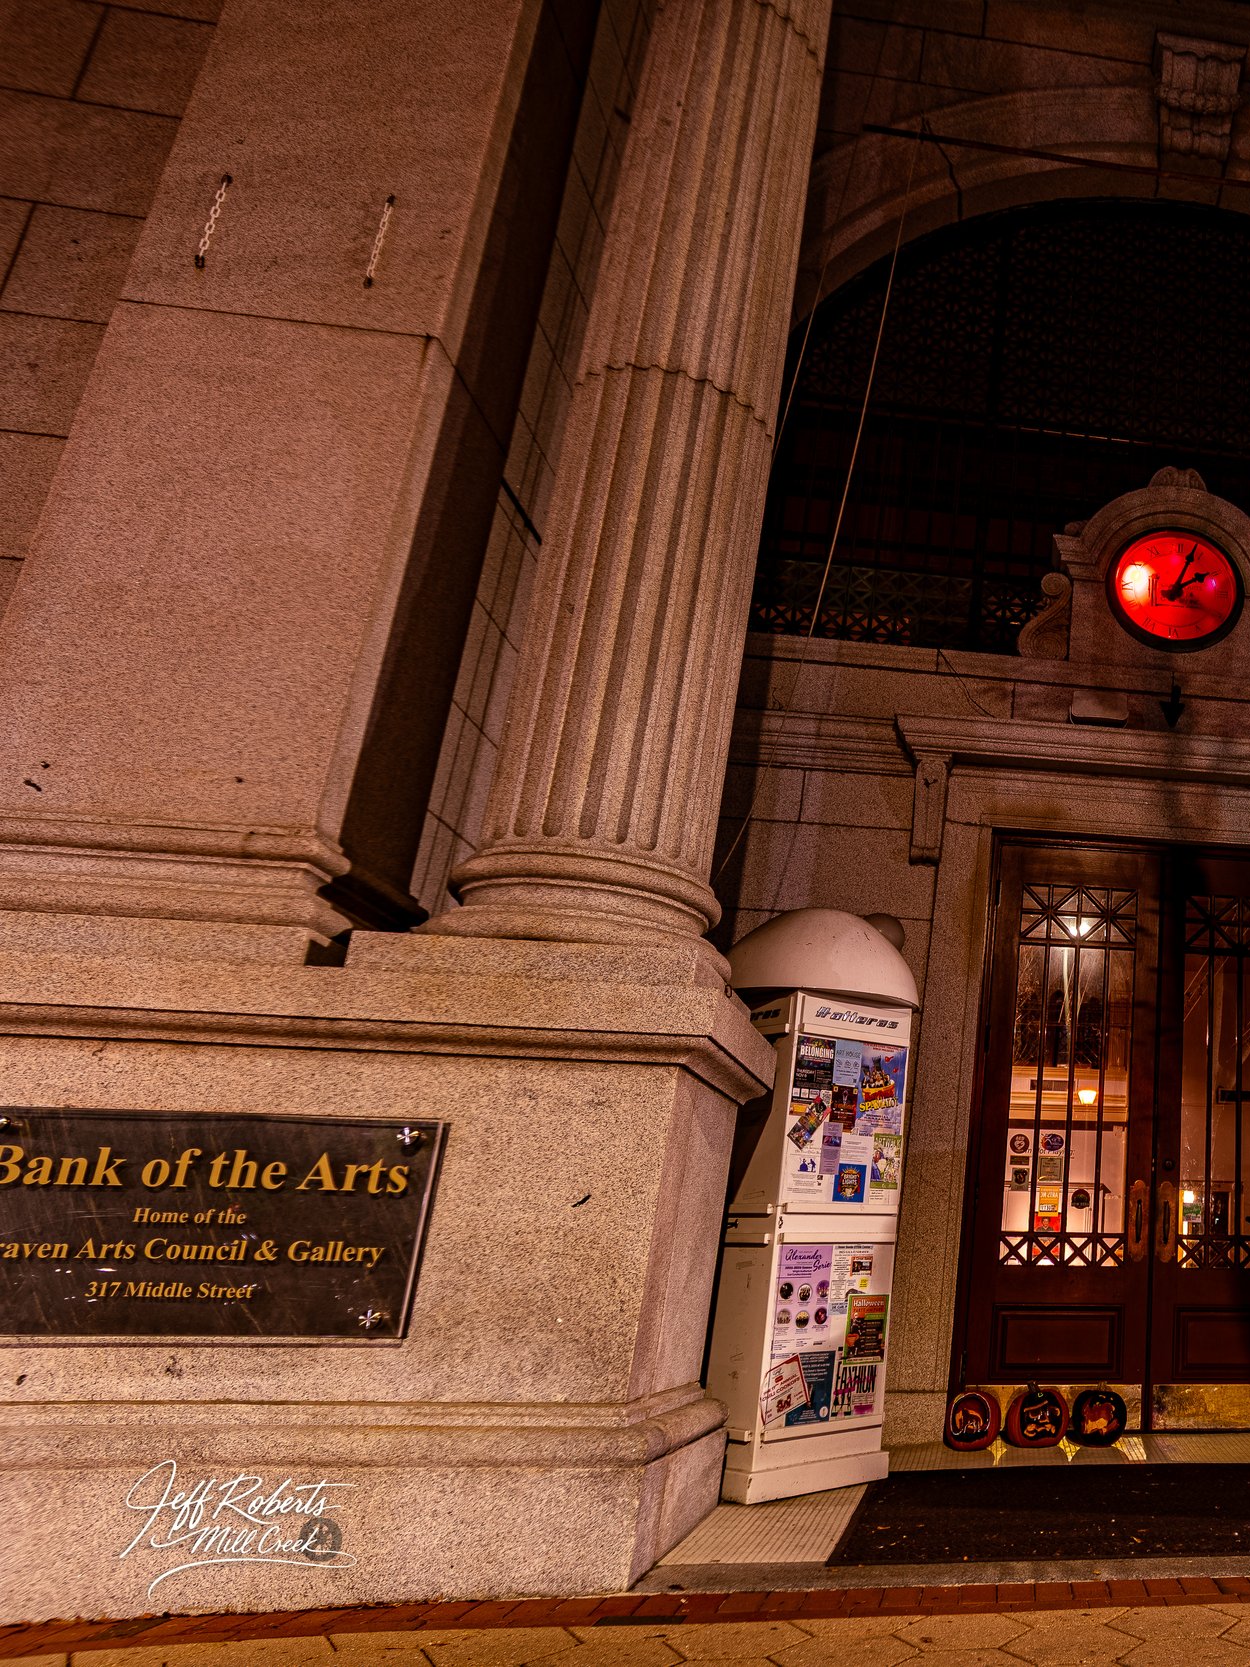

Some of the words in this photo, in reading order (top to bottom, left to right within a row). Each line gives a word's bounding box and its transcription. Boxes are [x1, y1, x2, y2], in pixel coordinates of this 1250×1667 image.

[815, 1006, 899, 1029] Hatteras
[800, 1045, 834, 1059] BELONGING
[859, 1096, 898, 1113] SPAMALOT
[0, 1144, 126, 1188] Bank
[141, 1147, 201, 1189] of
[209, 1149, 287, 1190] the
[297, 1152, 411, 1194] Arts
[133, 1208, 189, 1225] Home
[194, 1208, 216, 1225] of
[219, 1209, 246, 1225] the
[0, 1243, 67, 1259] aven
[75, 1238, 136, 1261] Arts
[145, 1239, 247, 1261] Council
[254, 1240, 278, 1261] &
[288, 1240, 385, 1268] Gallery
[785, 1249, 822, 1261] Alexander
[85, 1281, 121, 1298] 317
[124, 1282, 192, 1299] Middle
[197, 1282, 254, 1299] Street
[853, 1299, 885, 1307] Halloween
[780, 1374, 798, 1386] ANNUAL
[761, 1391, 776, 1402] CHILI
[776, 1377, 800, 1394] COOKOFF
